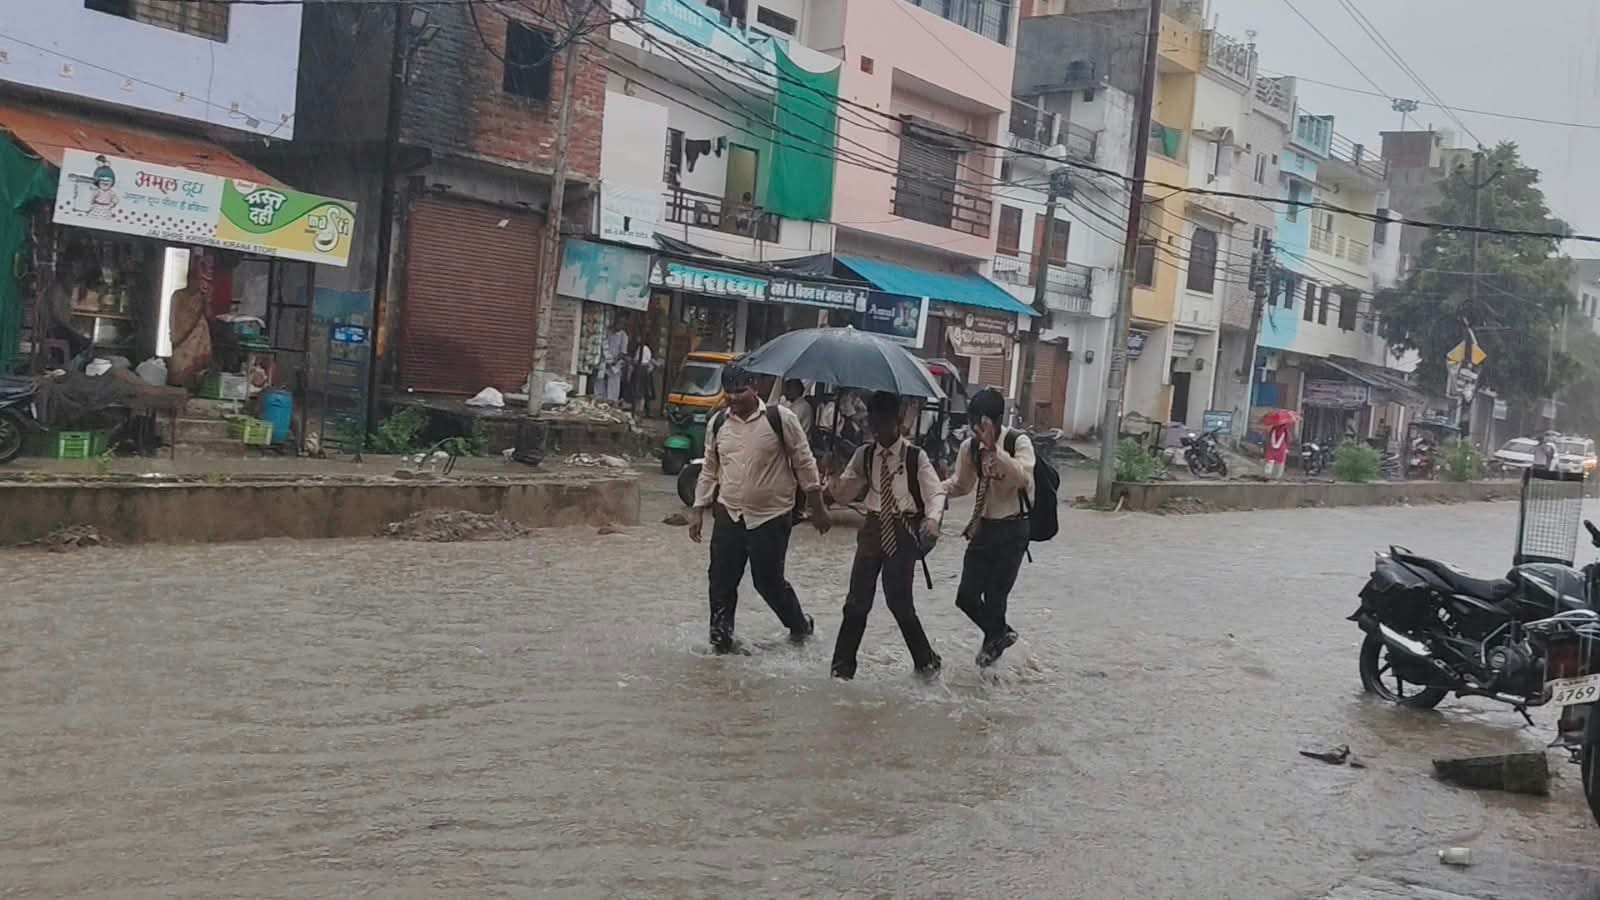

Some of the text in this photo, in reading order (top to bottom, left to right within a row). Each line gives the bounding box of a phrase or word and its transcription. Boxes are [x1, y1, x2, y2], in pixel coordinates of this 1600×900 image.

[134, 171, 205, 197] अमूल दूध
[249, 206, 274, 225] दही
[253, 244, 278, 254] STORE
